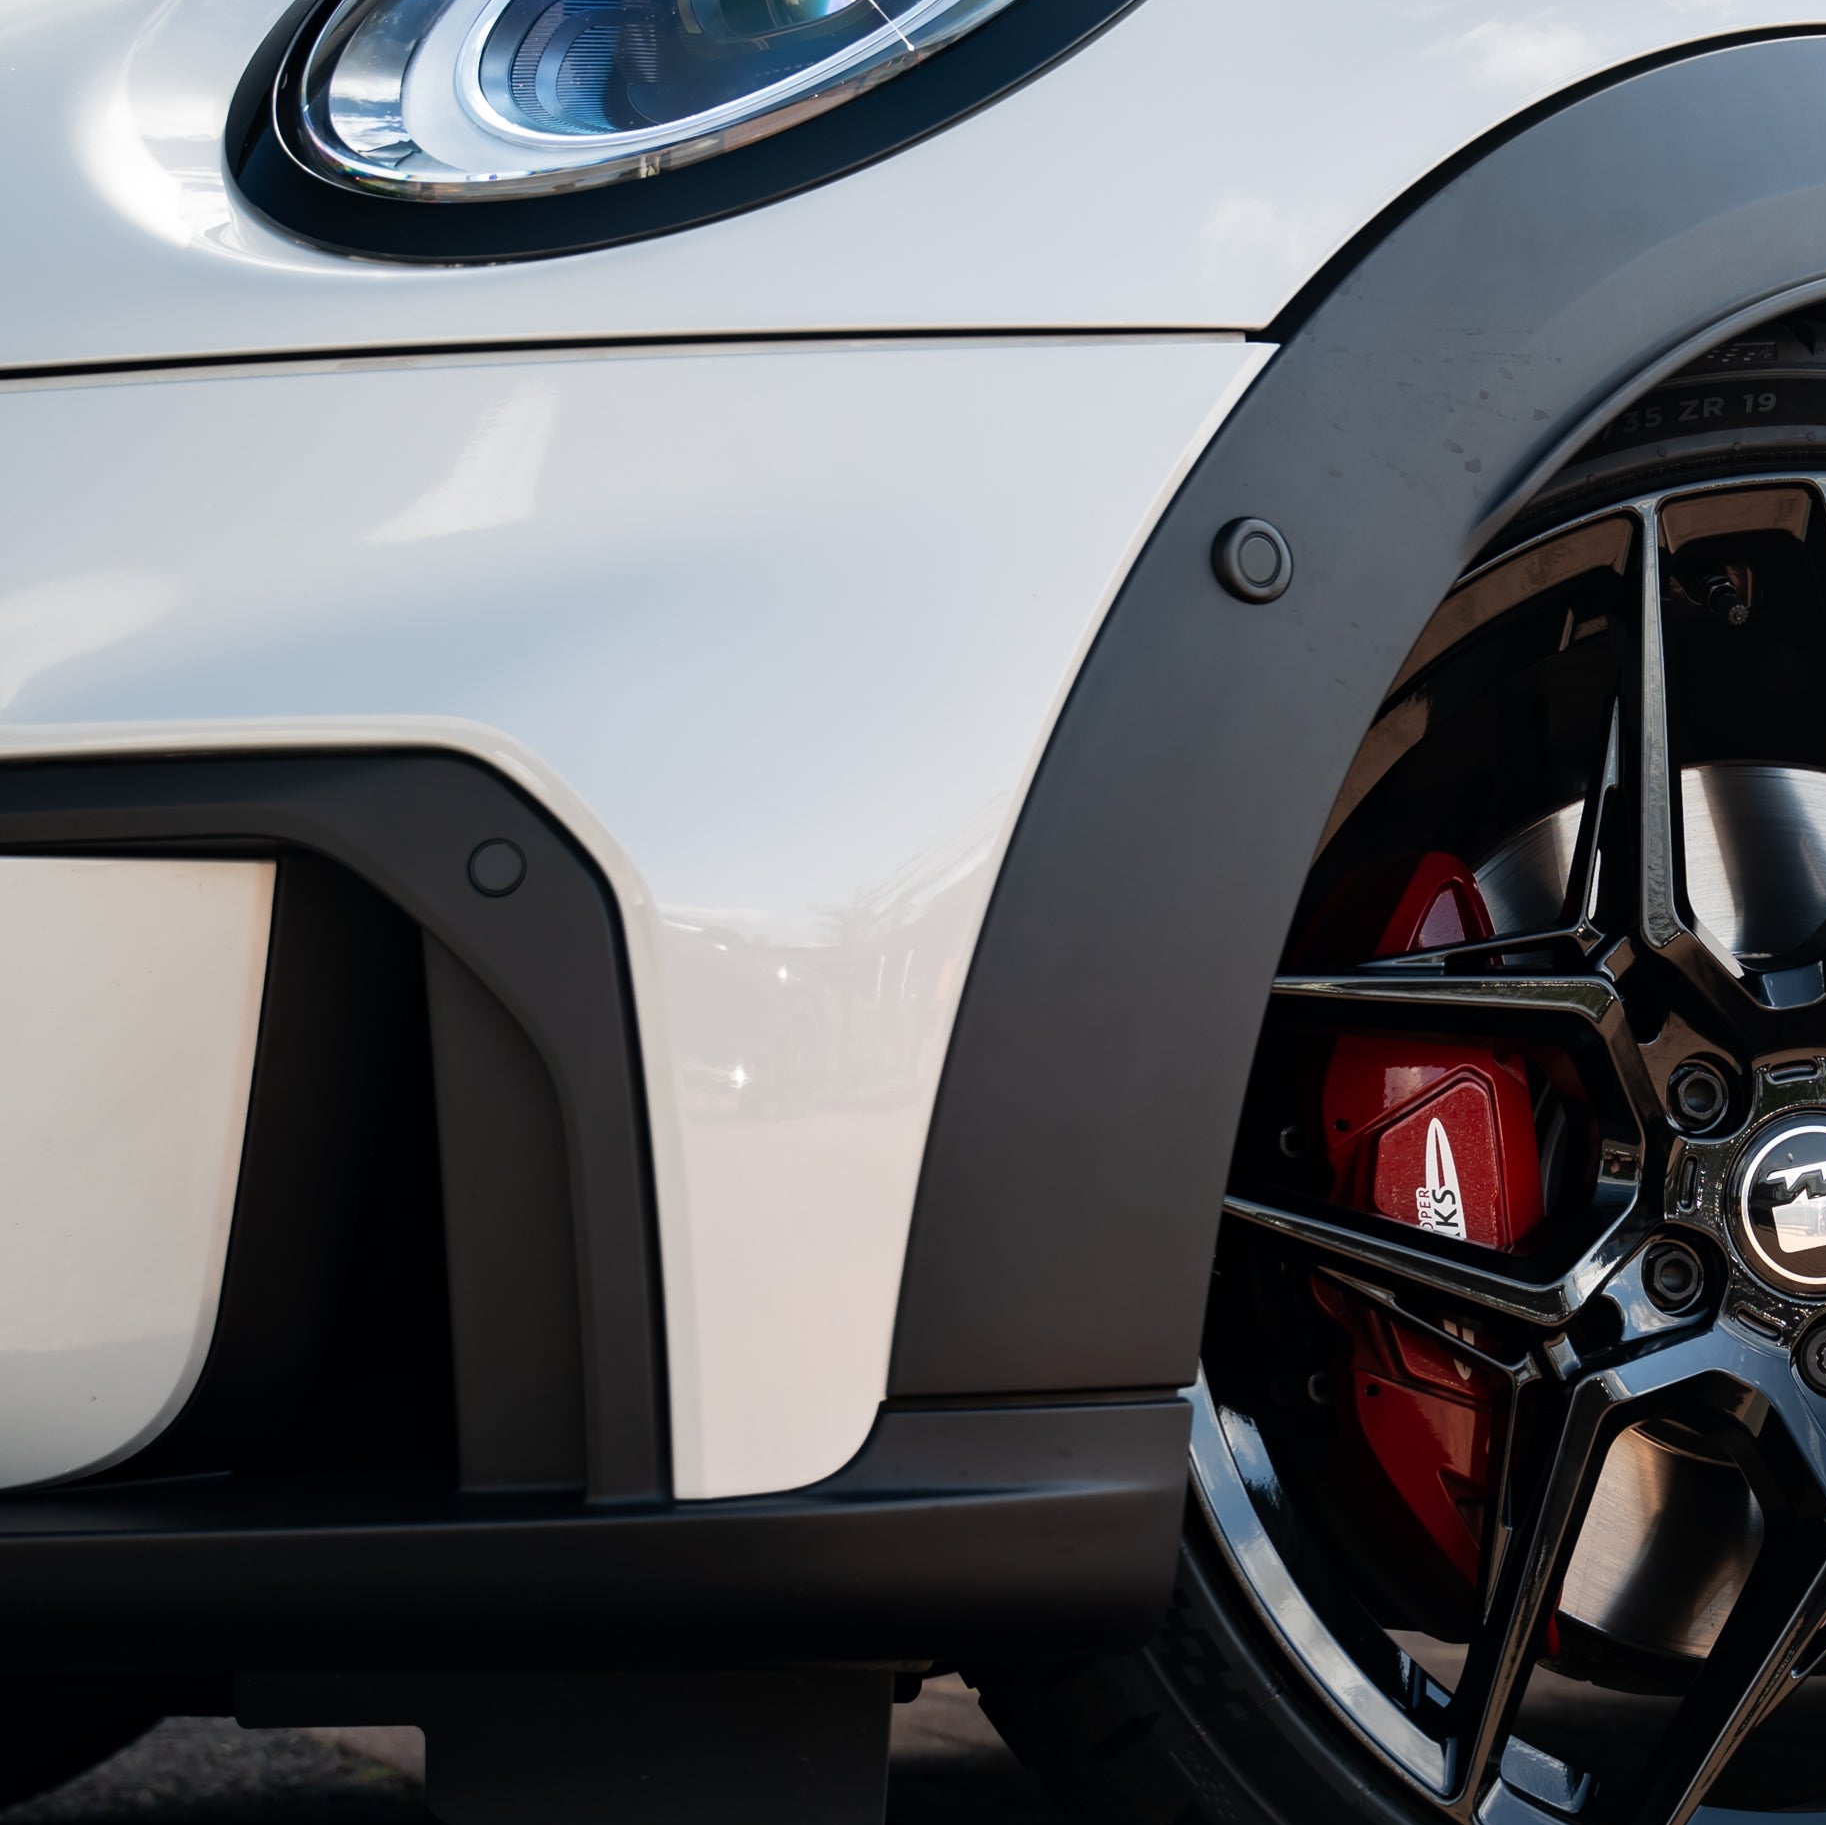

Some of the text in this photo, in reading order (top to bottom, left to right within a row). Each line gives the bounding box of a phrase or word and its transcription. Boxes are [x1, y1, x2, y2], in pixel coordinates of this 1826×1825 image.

[1678, 396, 1727, 423] ZR
[1742, 391, 1778, 416] 19
[1432, 1189, 1460, 1236] KS
